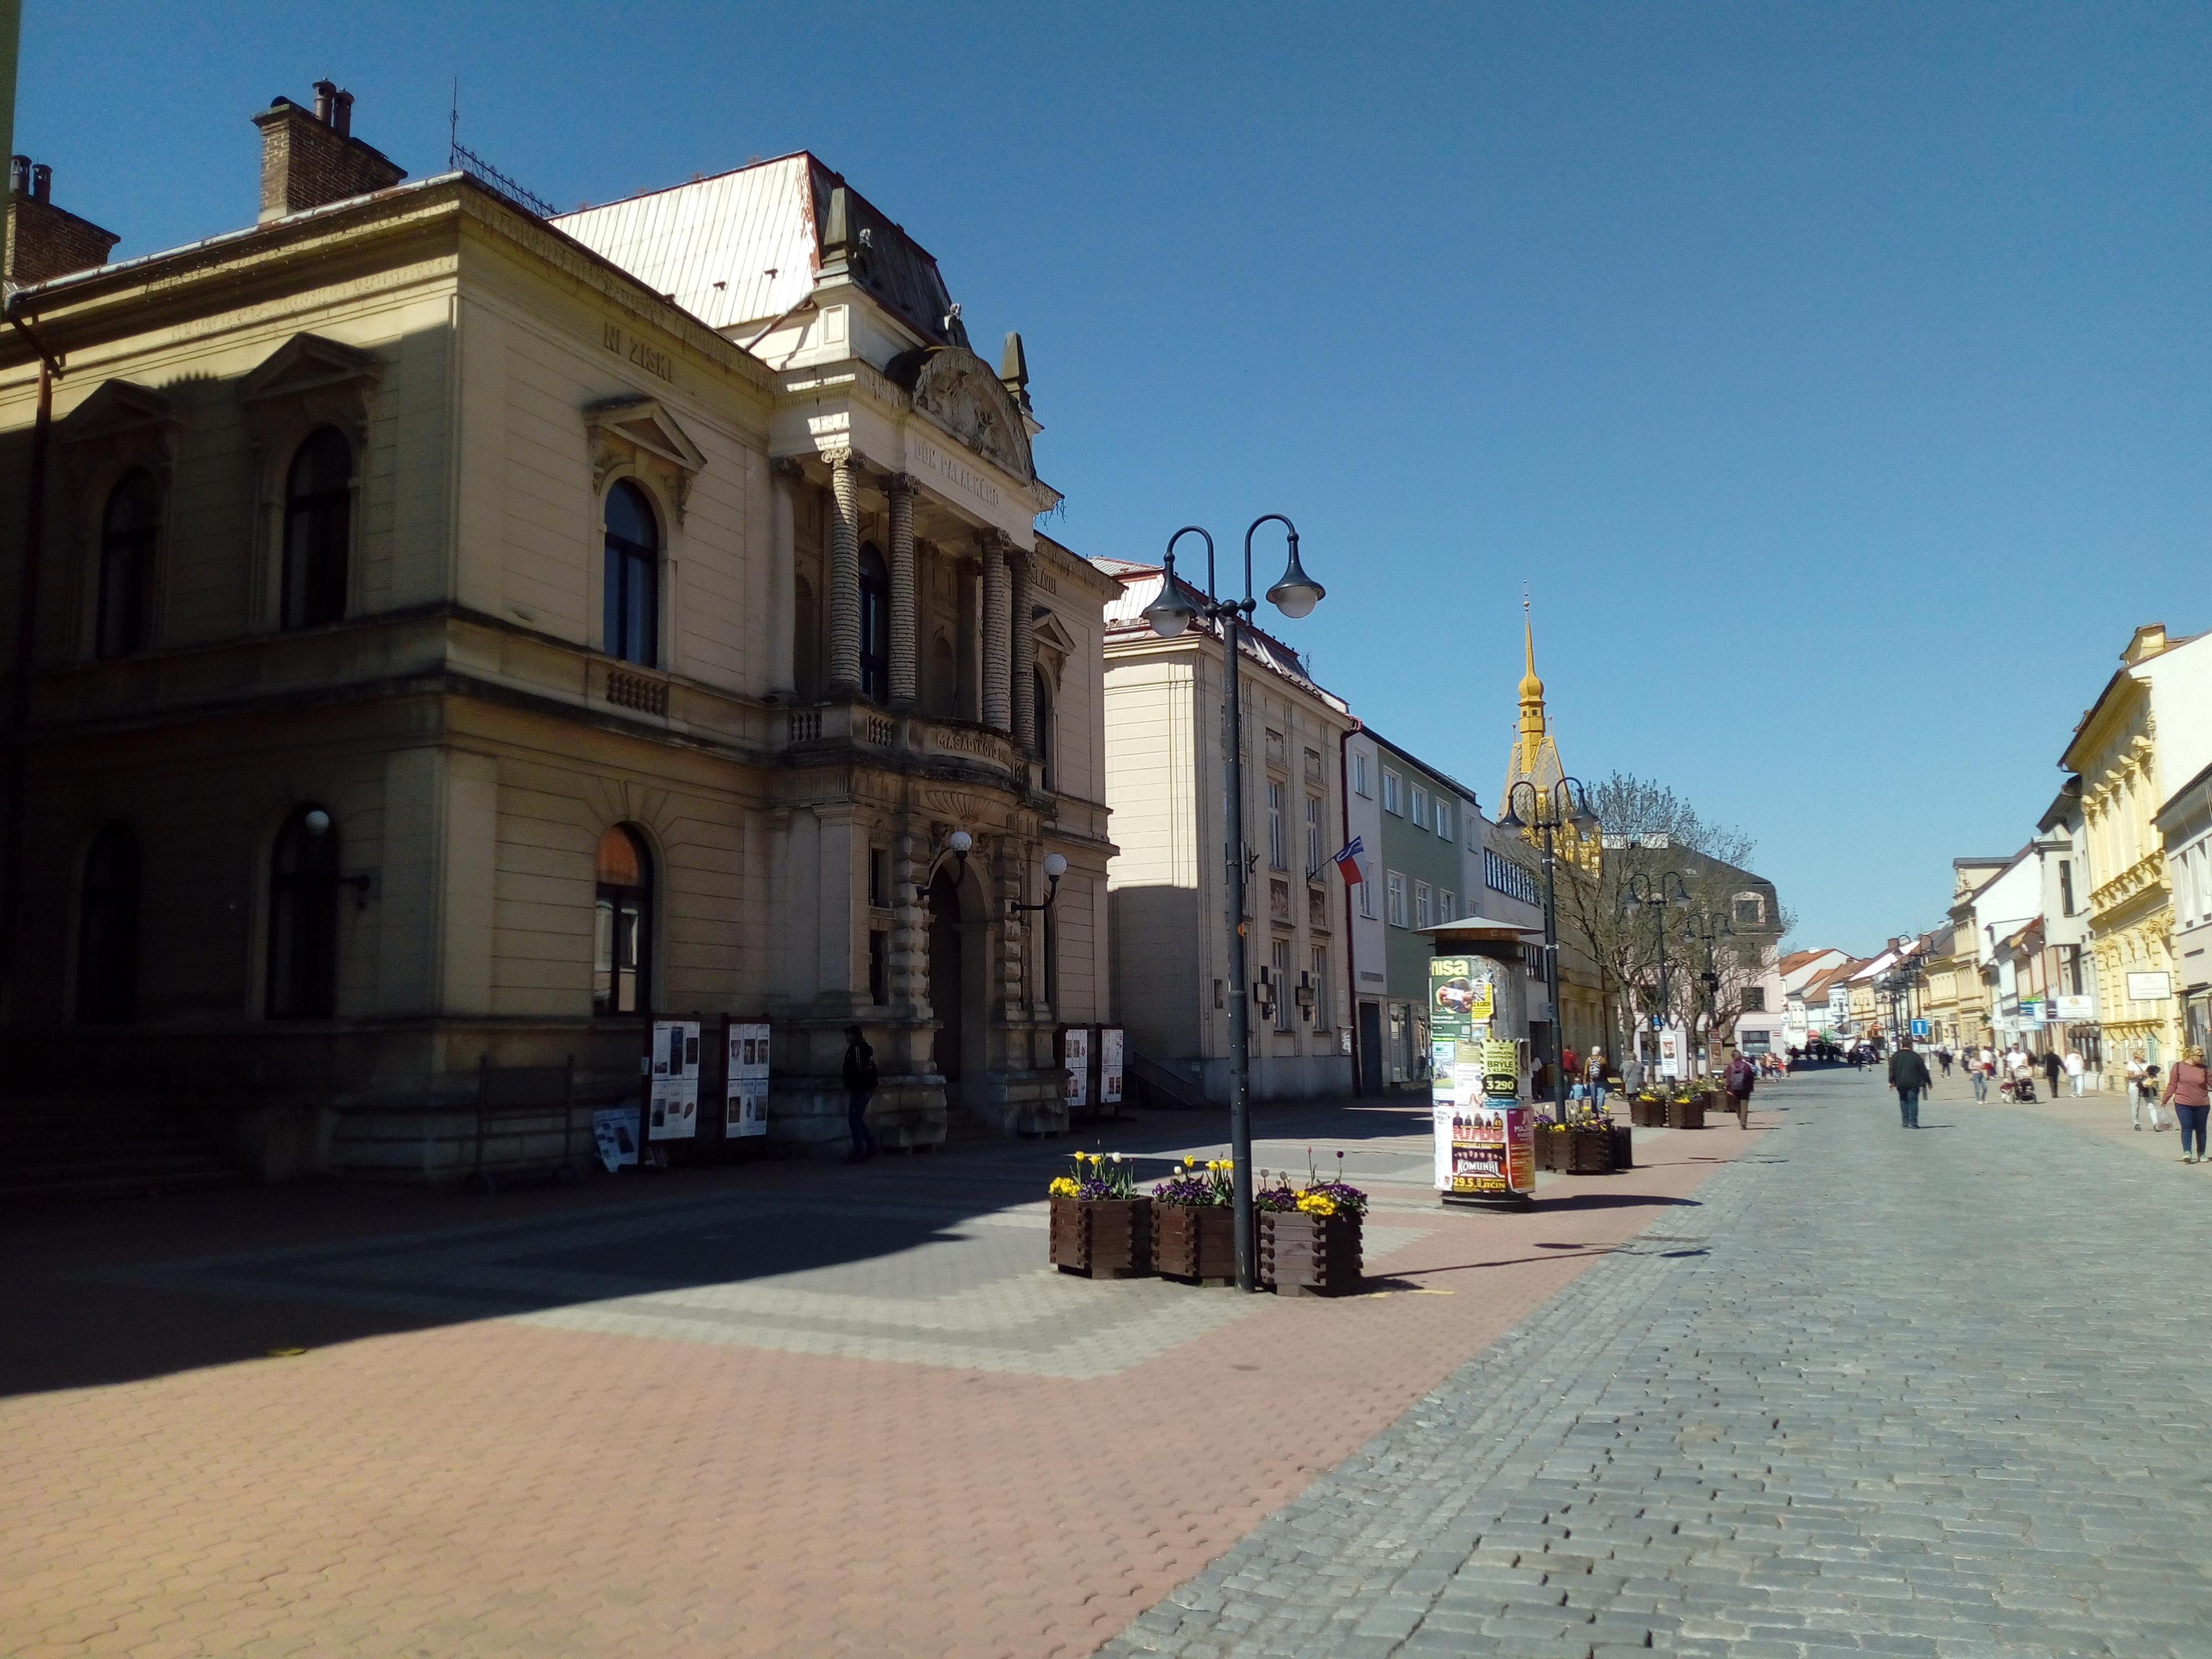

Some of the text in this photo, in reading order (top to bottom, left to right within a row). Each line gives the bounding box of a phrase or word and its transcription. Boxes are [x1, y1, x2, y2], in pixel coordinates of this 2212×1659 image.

[937, 734, 997, 759] MASARYKOVO
[1487, 1059, 1513, 1068] BRÝLE
[1453, 1176, 1477, 1187] 29.5.
